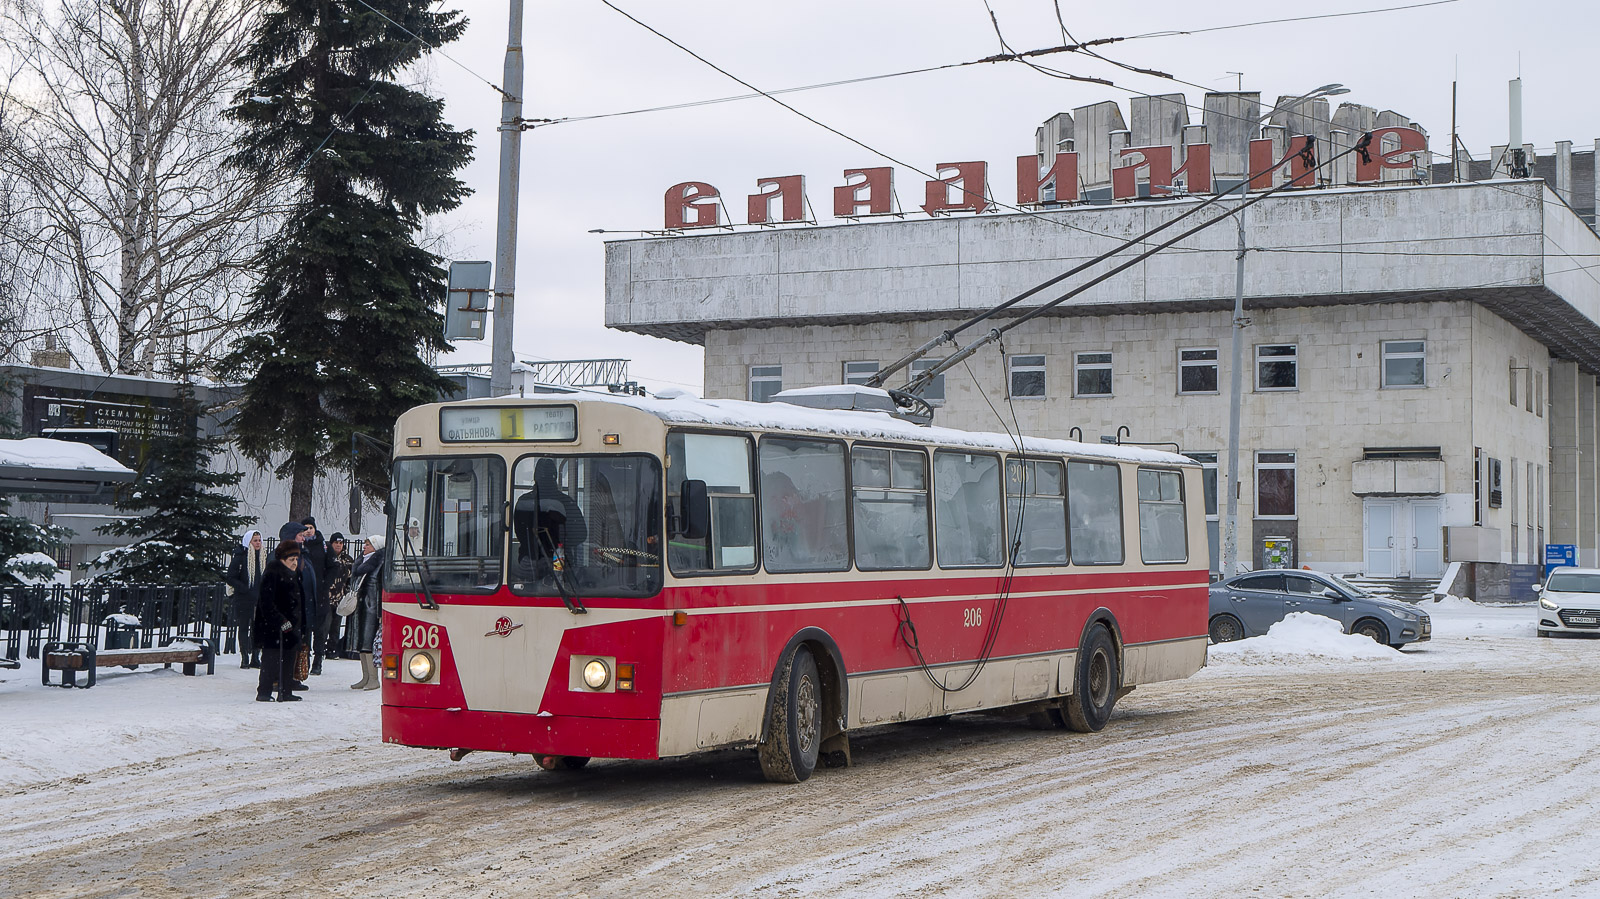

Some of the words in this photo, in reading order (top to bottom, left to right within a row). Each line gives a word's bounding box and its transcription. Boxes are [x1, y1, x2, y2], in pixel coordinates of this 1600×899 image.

[448, 426, 496, 440] ФАТЬЯНОВА
[506, 412, 521, 438] 1
[963, 607, 982, 628] 206
[401, 624, 439, 649] 206
